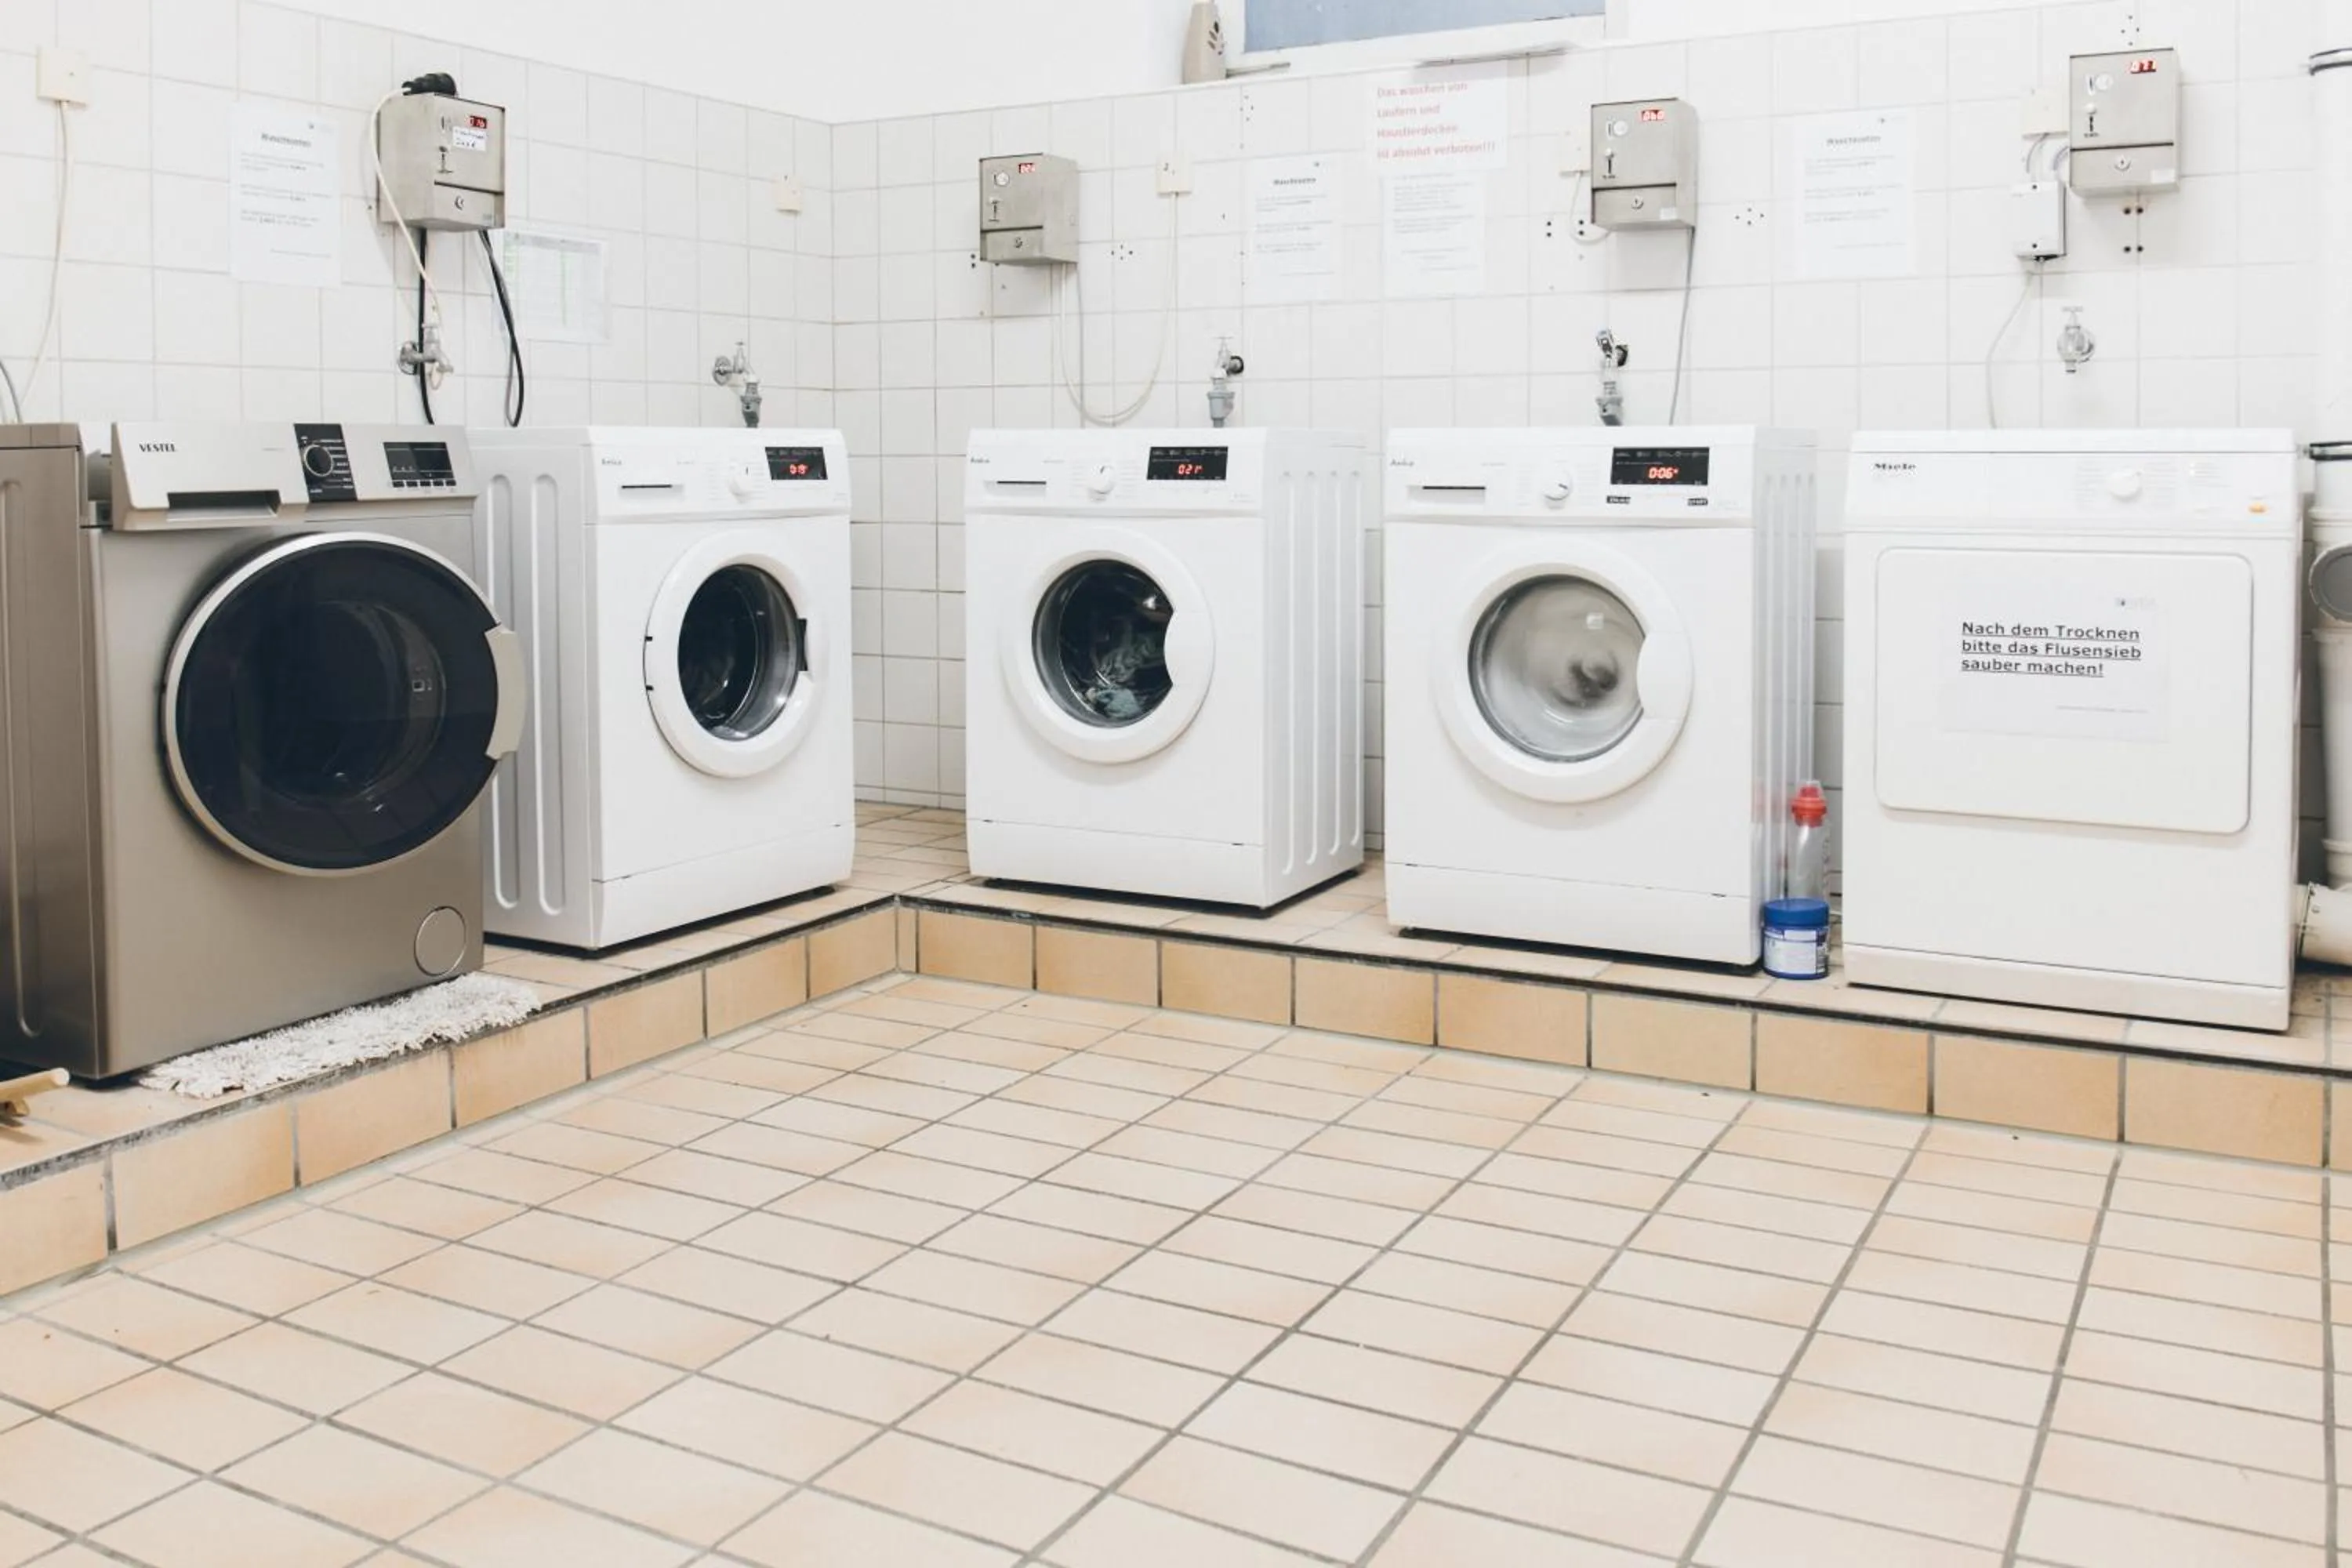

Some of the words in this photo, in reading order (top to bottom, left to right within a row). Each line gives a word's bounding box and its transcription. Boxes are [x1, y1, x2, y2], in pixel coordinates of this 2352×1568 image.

[138, 443, 177, 452] VESTEL
[1962, 622, 2004, 635] Nach
[2011, 624, 2049, 637] dem
[2054, 625, 2140, 640] Trocknen
[1962, 641, 2002, 652] bitte
[2008, 641, 2038, 655] das
[2045, 643, 2142, 659] Flusensieb
[1962, 659, 2021, 671] sauber
[2027, 662, 2103, 674] machen!
